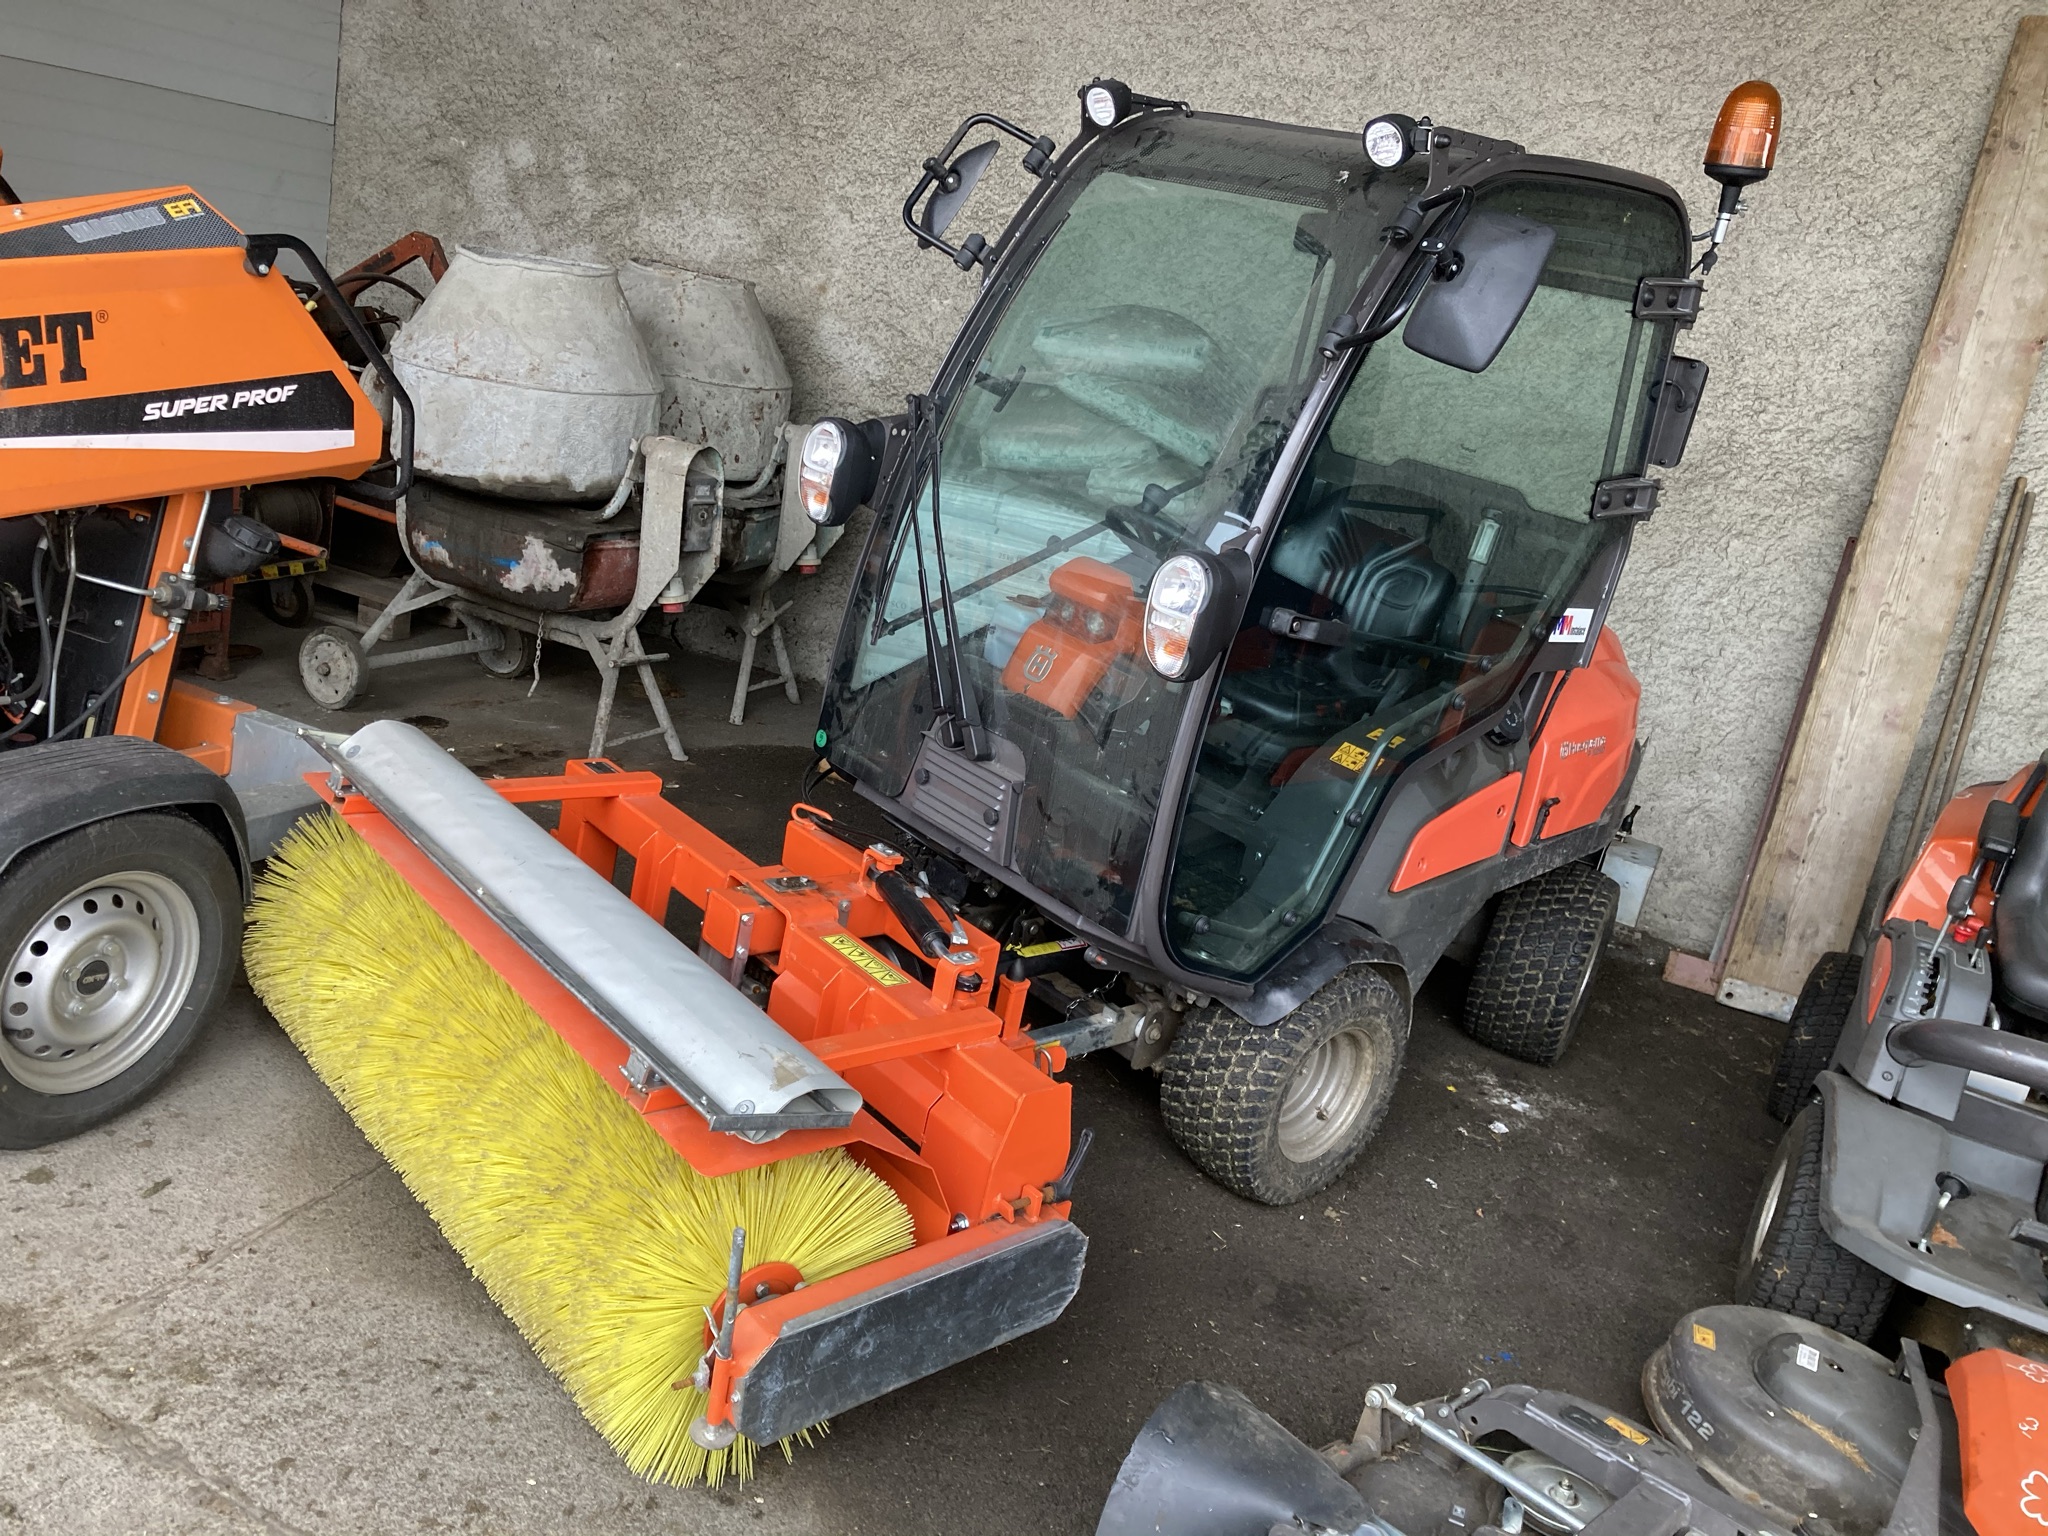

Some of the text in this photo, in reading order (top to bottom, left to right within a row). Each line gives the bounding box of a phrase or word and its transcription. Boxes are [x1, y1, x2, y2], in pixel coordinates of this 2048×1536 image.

[61, 198, 202, 244] VANGUARD EFI
[142, 384, 299, 422] SUPER PROF
[1680, 1399, 1715, 1442] 122
